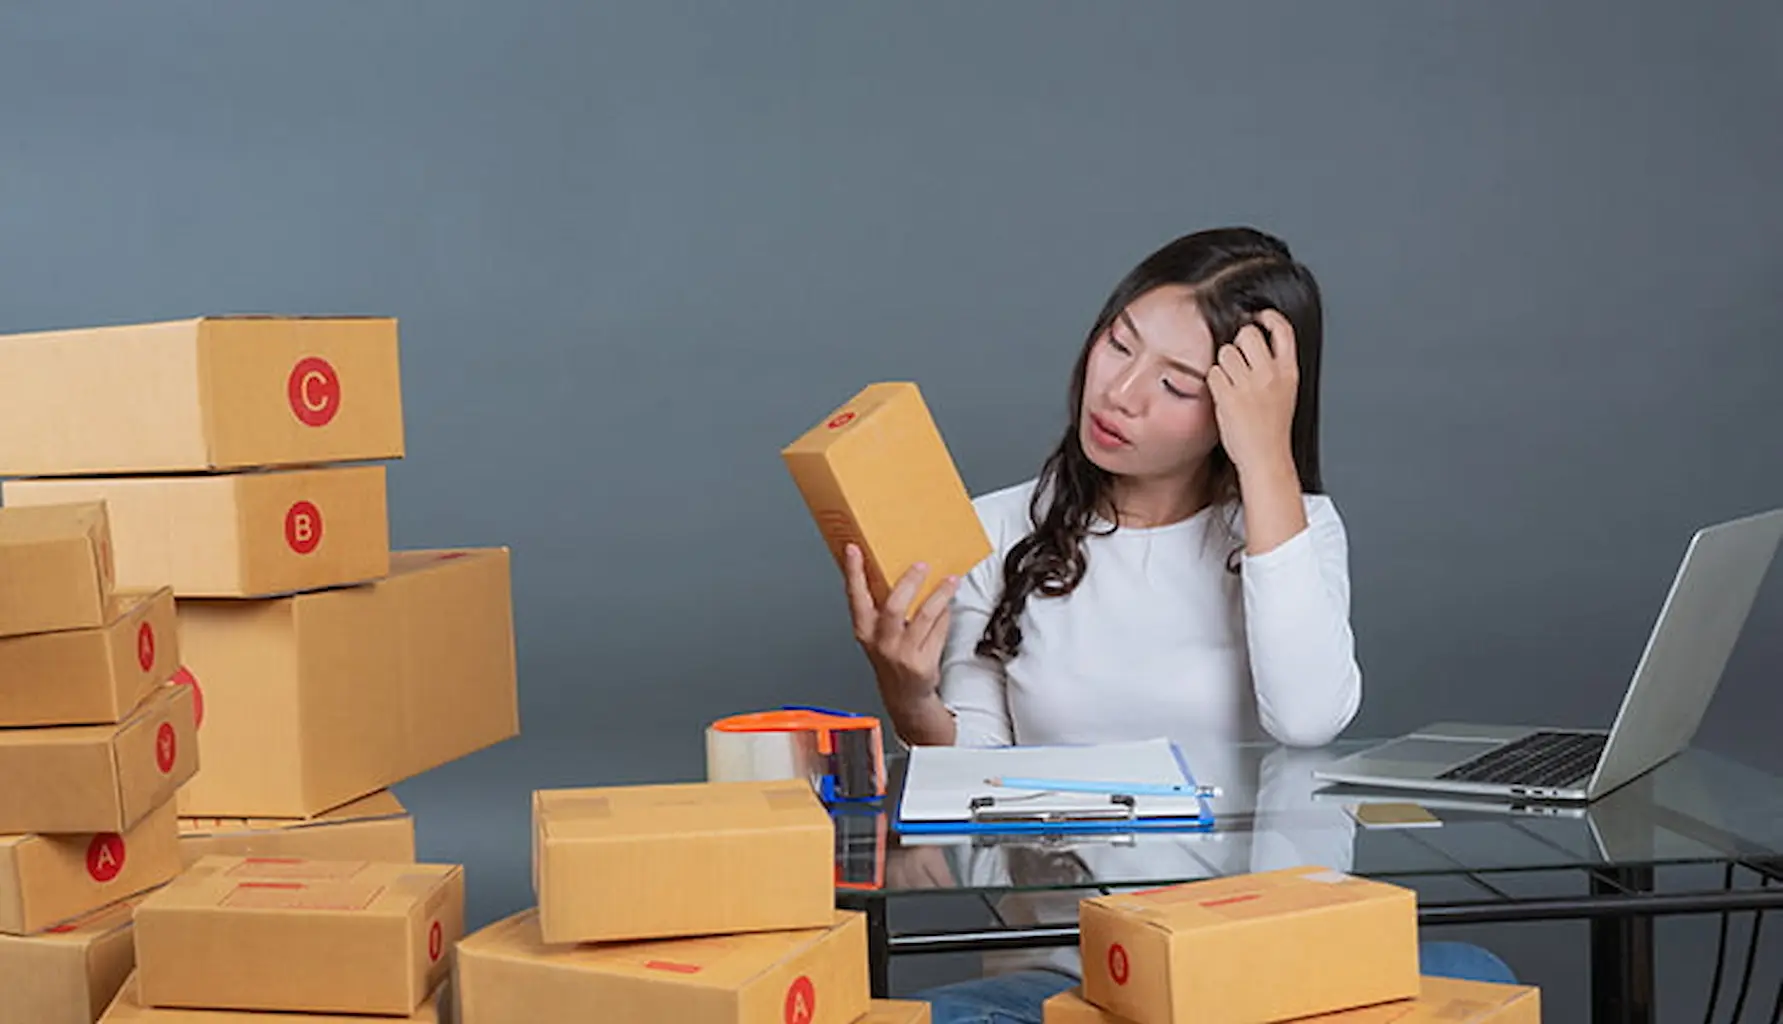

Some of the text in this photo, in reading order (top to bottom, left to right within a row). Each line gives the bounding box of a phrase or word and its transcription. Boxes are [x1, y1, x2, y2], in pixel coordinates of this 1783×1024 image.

[301, 371, 328, 412] C
[295, 514, 313, 542] B
[97, 844, 116, 870] A
[792, 991, 809, 1022] A
